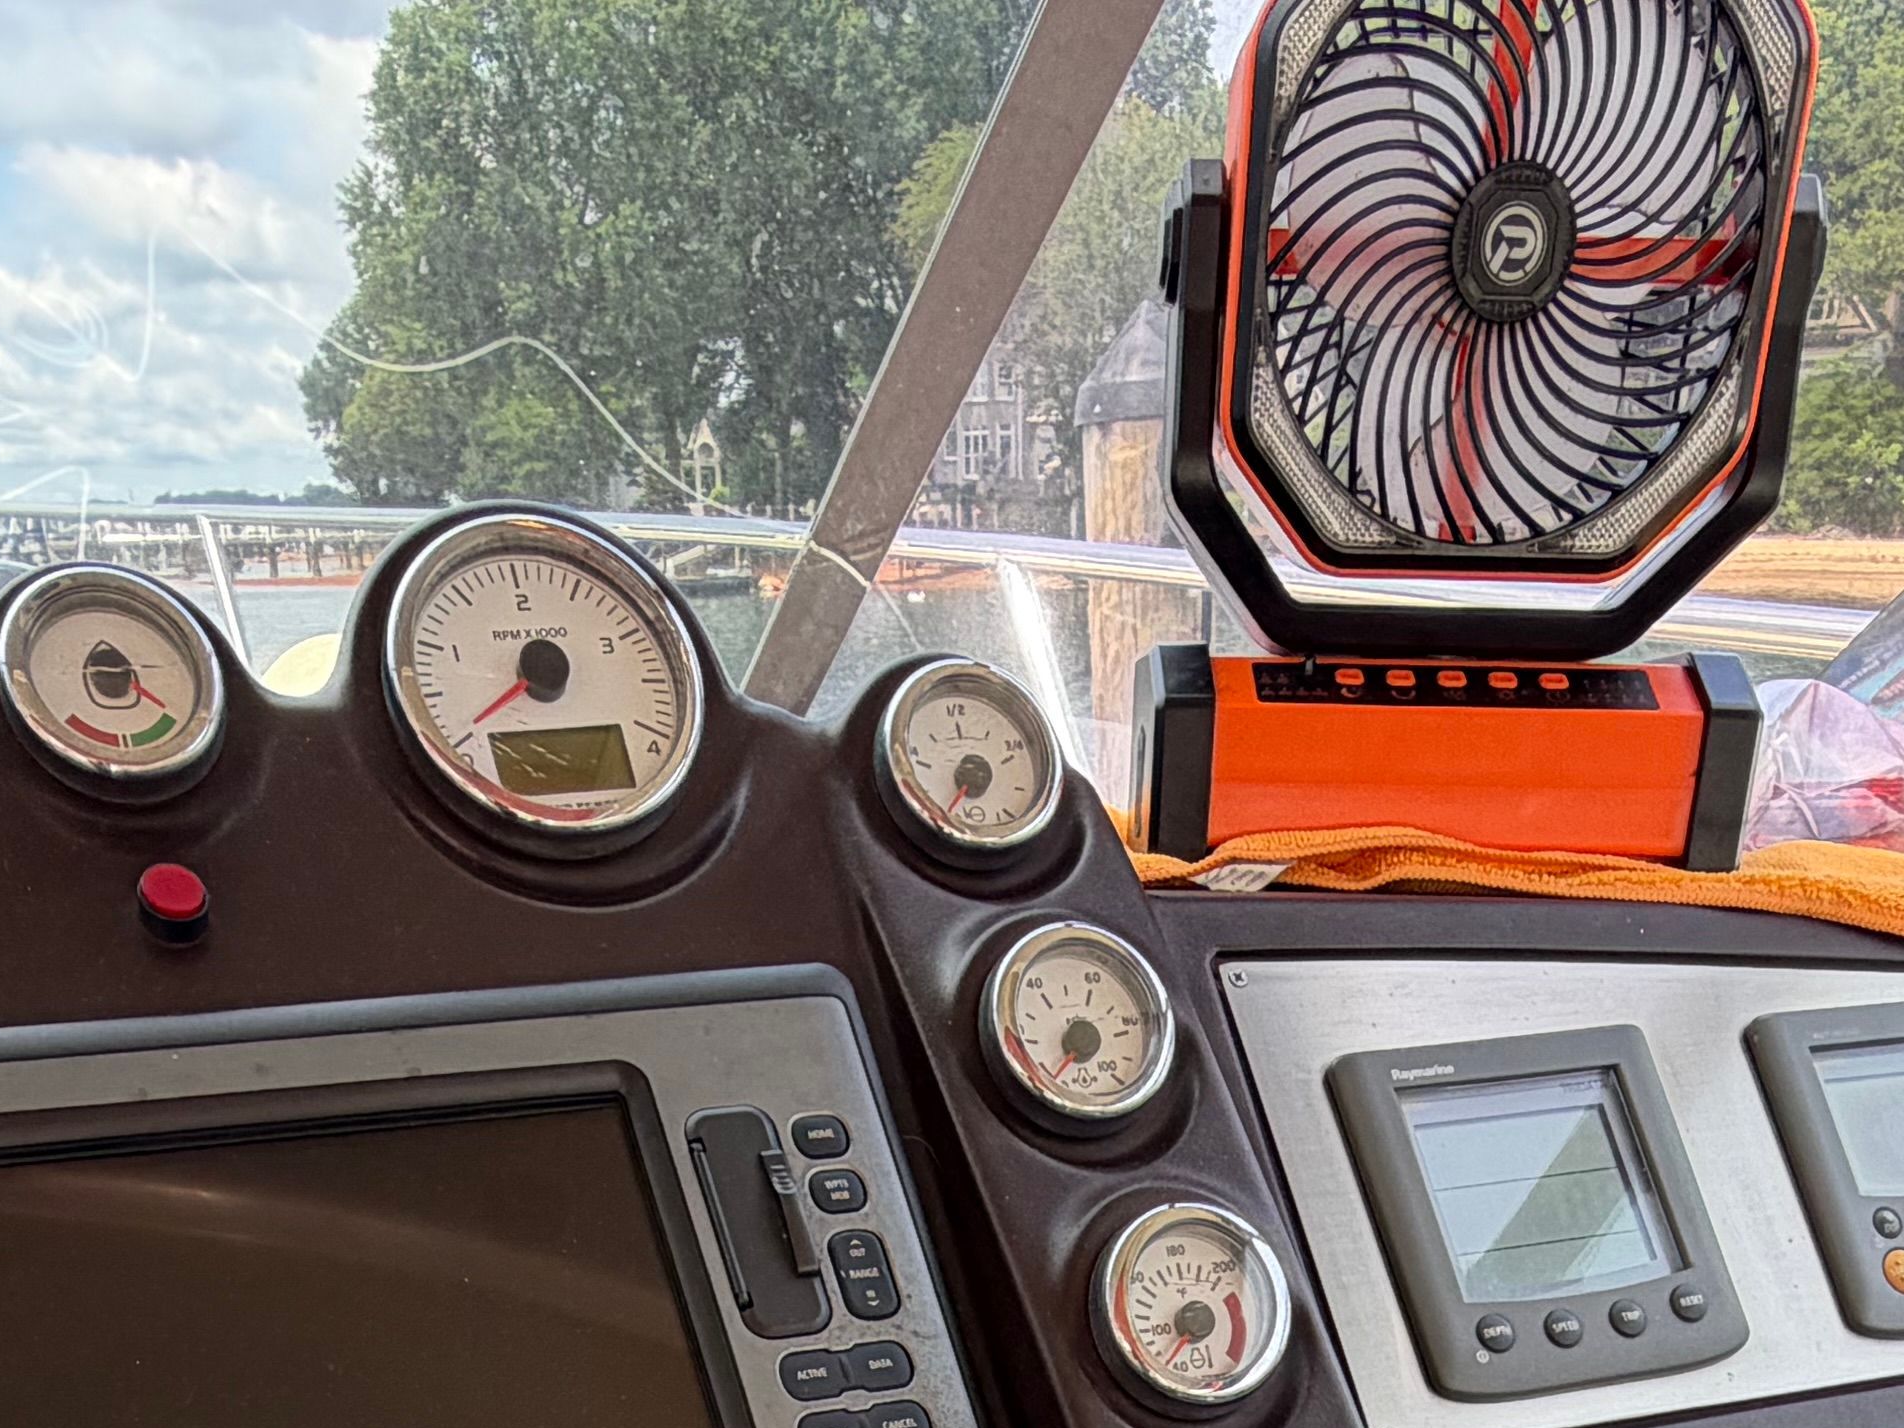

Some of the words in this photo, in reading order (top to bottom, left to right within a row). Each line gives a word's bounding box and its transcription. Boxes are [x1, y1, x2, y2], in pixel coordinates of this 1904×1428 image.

[514, 593, 532, 612] 2
[492, 628, 522, 643] RPM
[535, 626, 568, 639] 1000
[599, 636, 616, 654] 3
[452, 644, 461, 663] 1
[646, 739, 663, 757] 4
[1026, 977, 1042, 989] 40
[1085, 972, 1101, 983] 60
[1097, 1060, 1117, 1072] 100
[807, 1128, 835, 1140] HOME
[1212, 1259, 1236, 1273] 200
[1151, 1323, 1172, 1336] 100
[797, 1367, 828, 1380] ACTIVE
